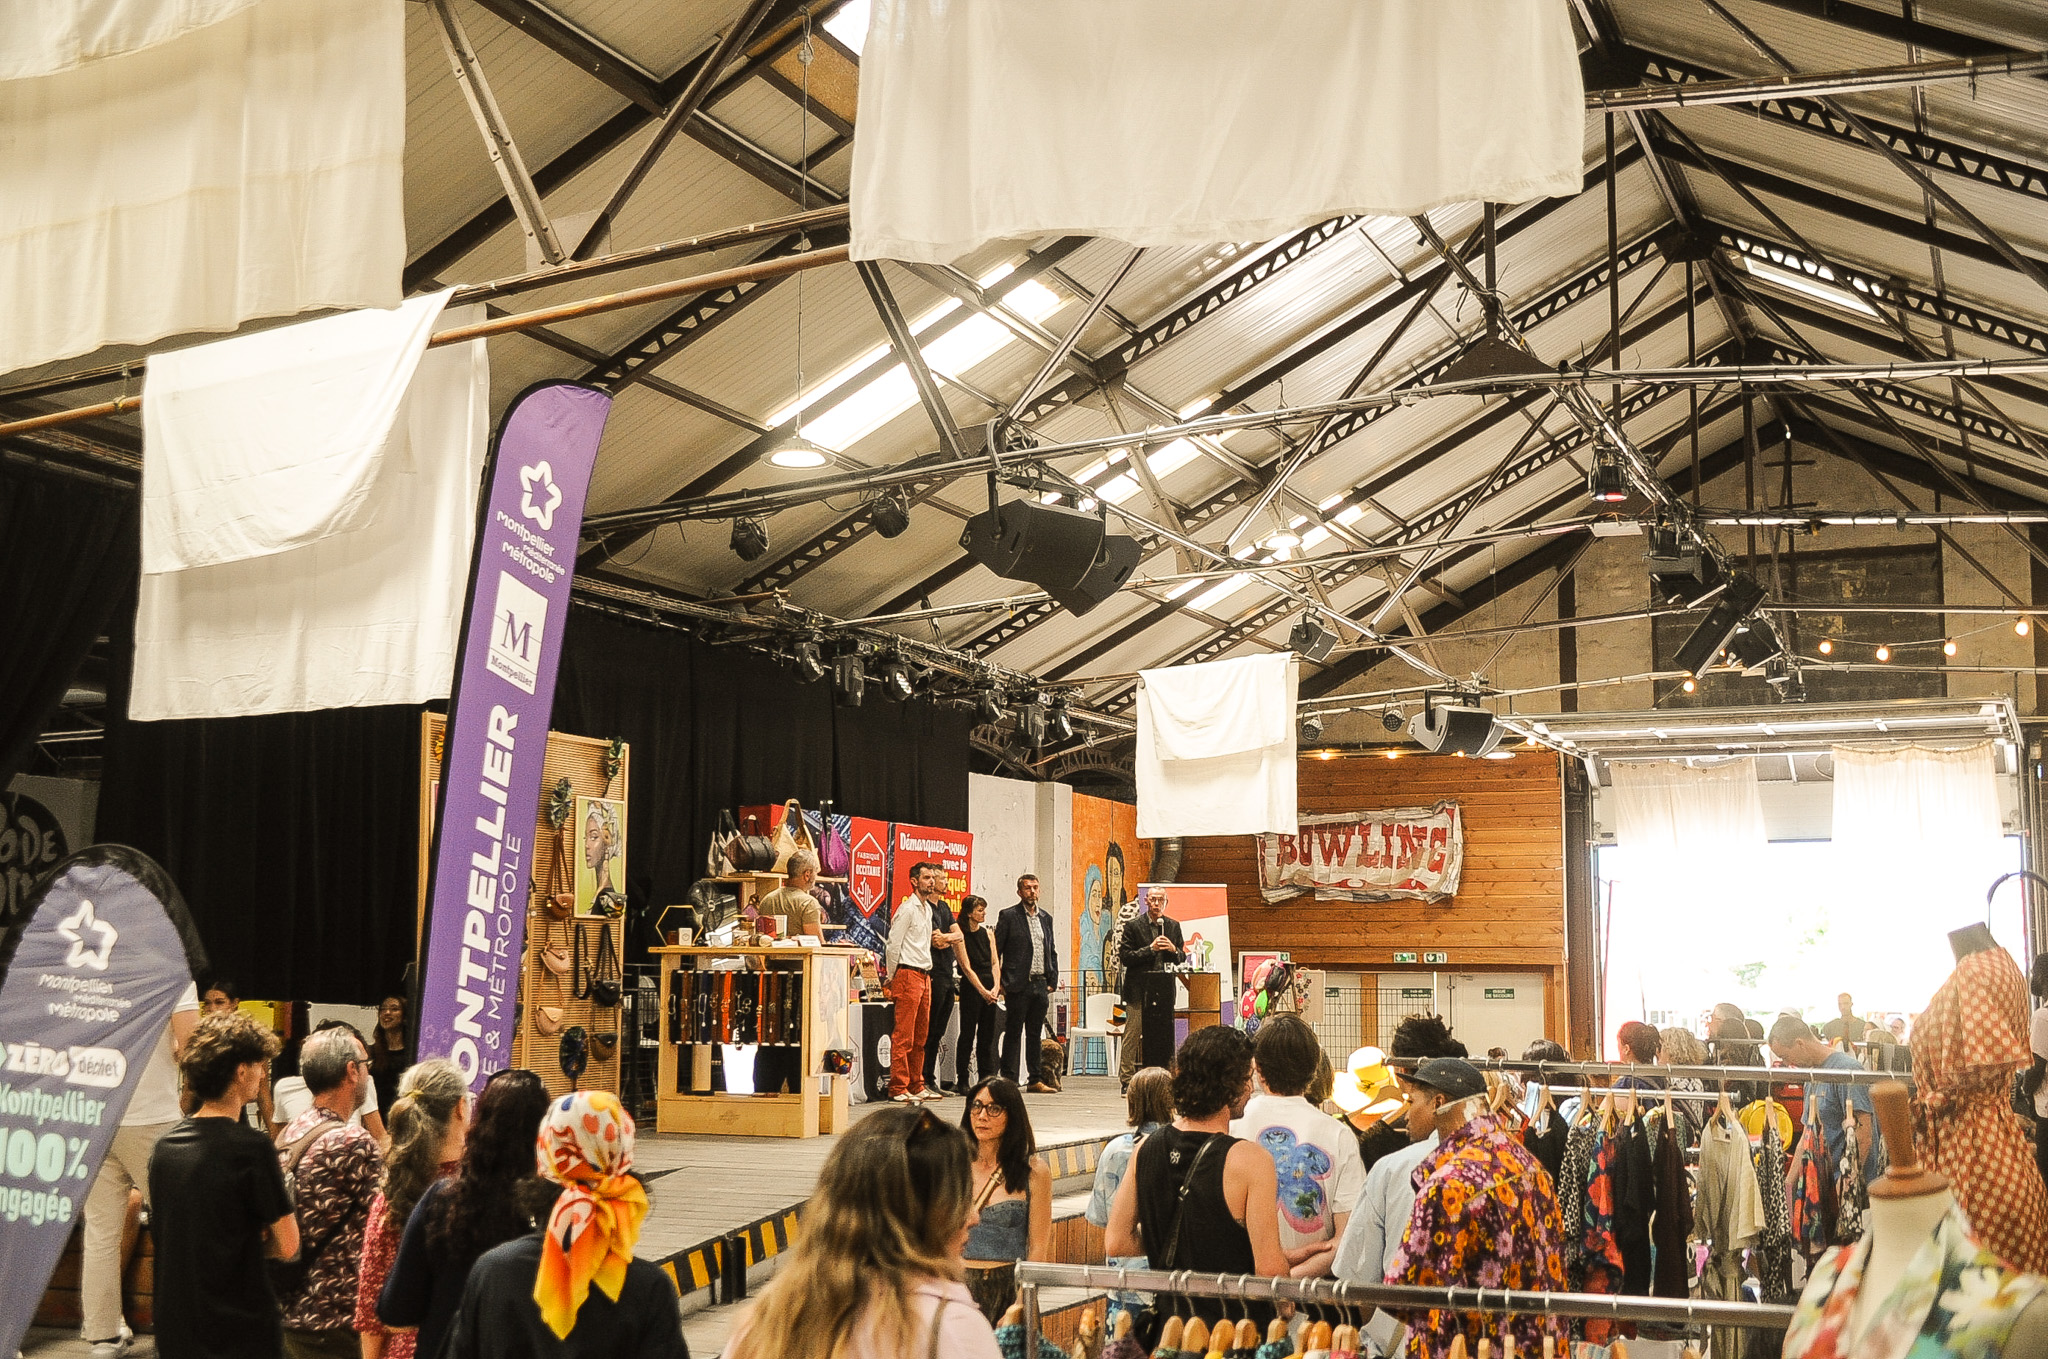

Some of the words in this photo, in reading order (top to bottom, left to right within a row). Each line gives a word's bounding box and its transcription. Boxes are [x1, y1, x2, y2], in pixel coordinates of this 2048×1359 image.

[496, 510, 556, 557] Montpellier
[502, 541, 556, 584] Métropole
[501, 609, 533, 662] M
[490, 655, 533, 687] Montpellier
[942, 859, 959, 871] avec
[960, 859, 967, 872] le
[1276, 822, 1448, 874] BOWLING
[855, 864, 881, 877] OCCITANIE
[451, 704, 519, 1094] ONTPELLIER
[486, 833, 522, 1021] MÉTROPOLE
[38, 974, 114, 994] Montpellier
[48, 1002, 120, 1022] Métropole
[484, 1029, 501, 1050] &
[0, 1127, 91, 1182] 100%
[0, 1186, 73, 1226] ngagée
